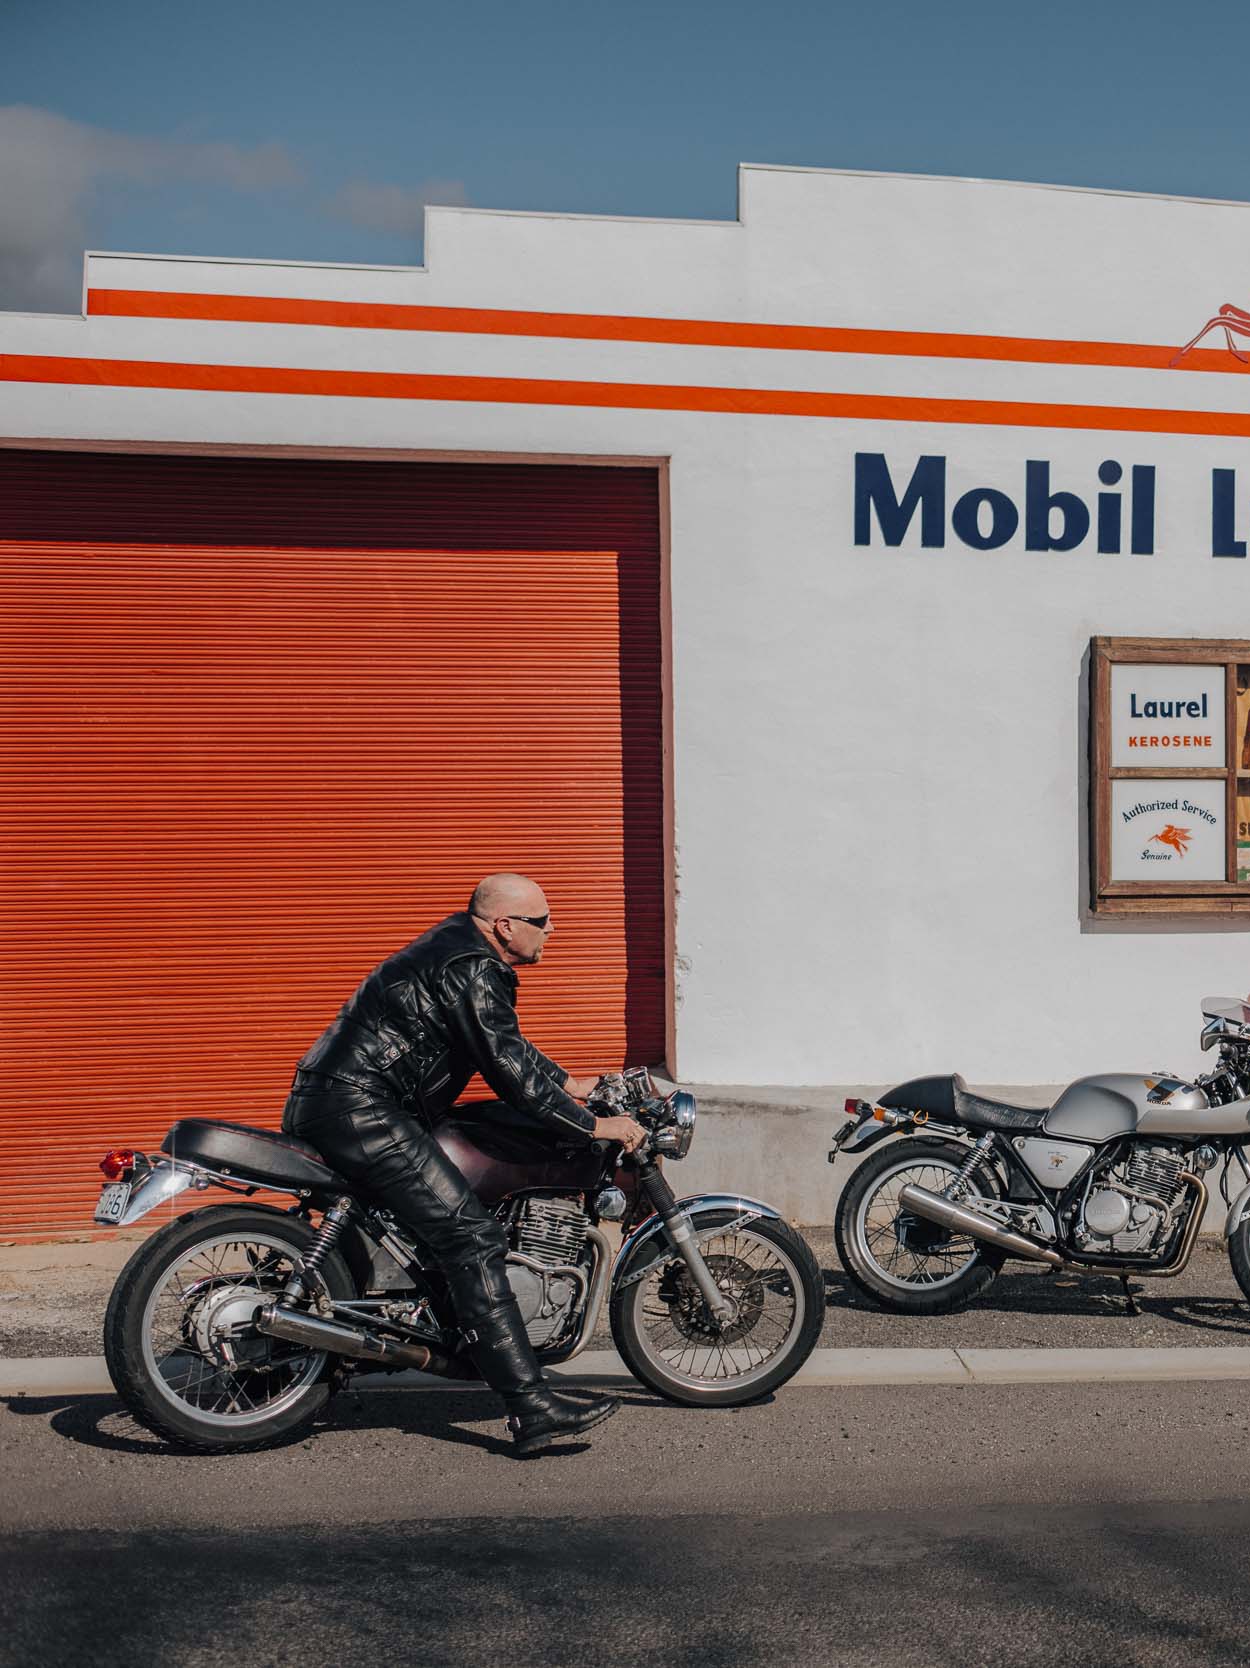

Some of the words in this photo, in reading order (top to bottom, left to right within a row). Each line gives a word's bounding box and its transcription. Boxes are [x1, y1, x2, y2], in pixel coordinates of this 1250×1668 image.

[854, 452, 1156, 555] Mobil
[1130, 693, 1207, 718] Laurel
[1129, 736, 1212, 747] KEROSENE
[1122, 800, 1178, 823] Authorized
[1182, 800, 1217, 825] Service
